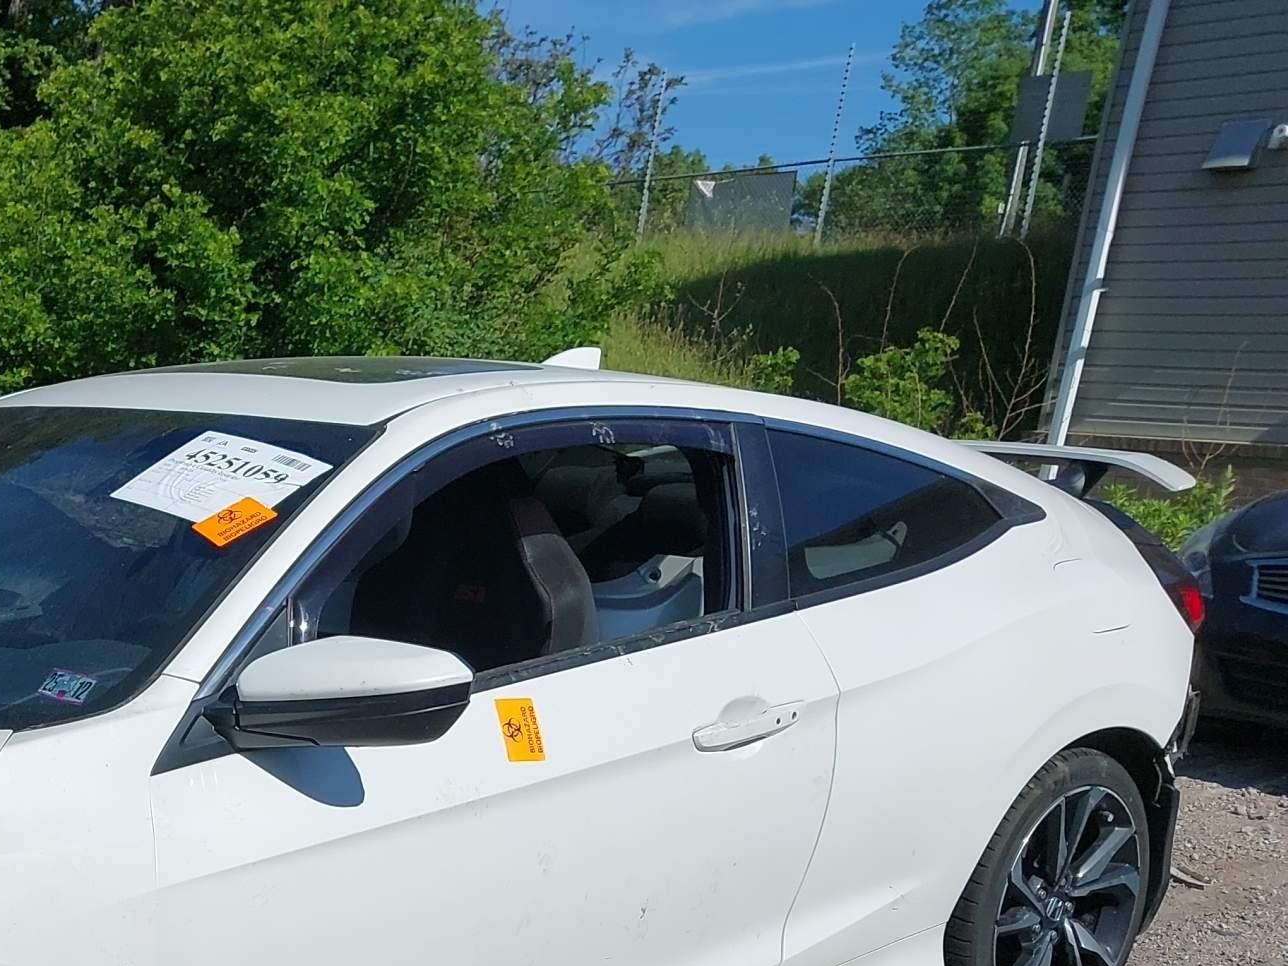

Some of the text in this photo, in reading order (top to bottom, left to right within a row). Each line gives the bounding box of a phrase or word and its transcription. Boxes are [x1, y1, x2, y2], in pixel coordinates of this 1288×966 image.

[185, 448, 289, 484] 45251059
[217, 511, 262, 537] BIOHAZARD
[71, 681, 93, 700] 12
[520, 706, 536, 754] BIOHAZARD
